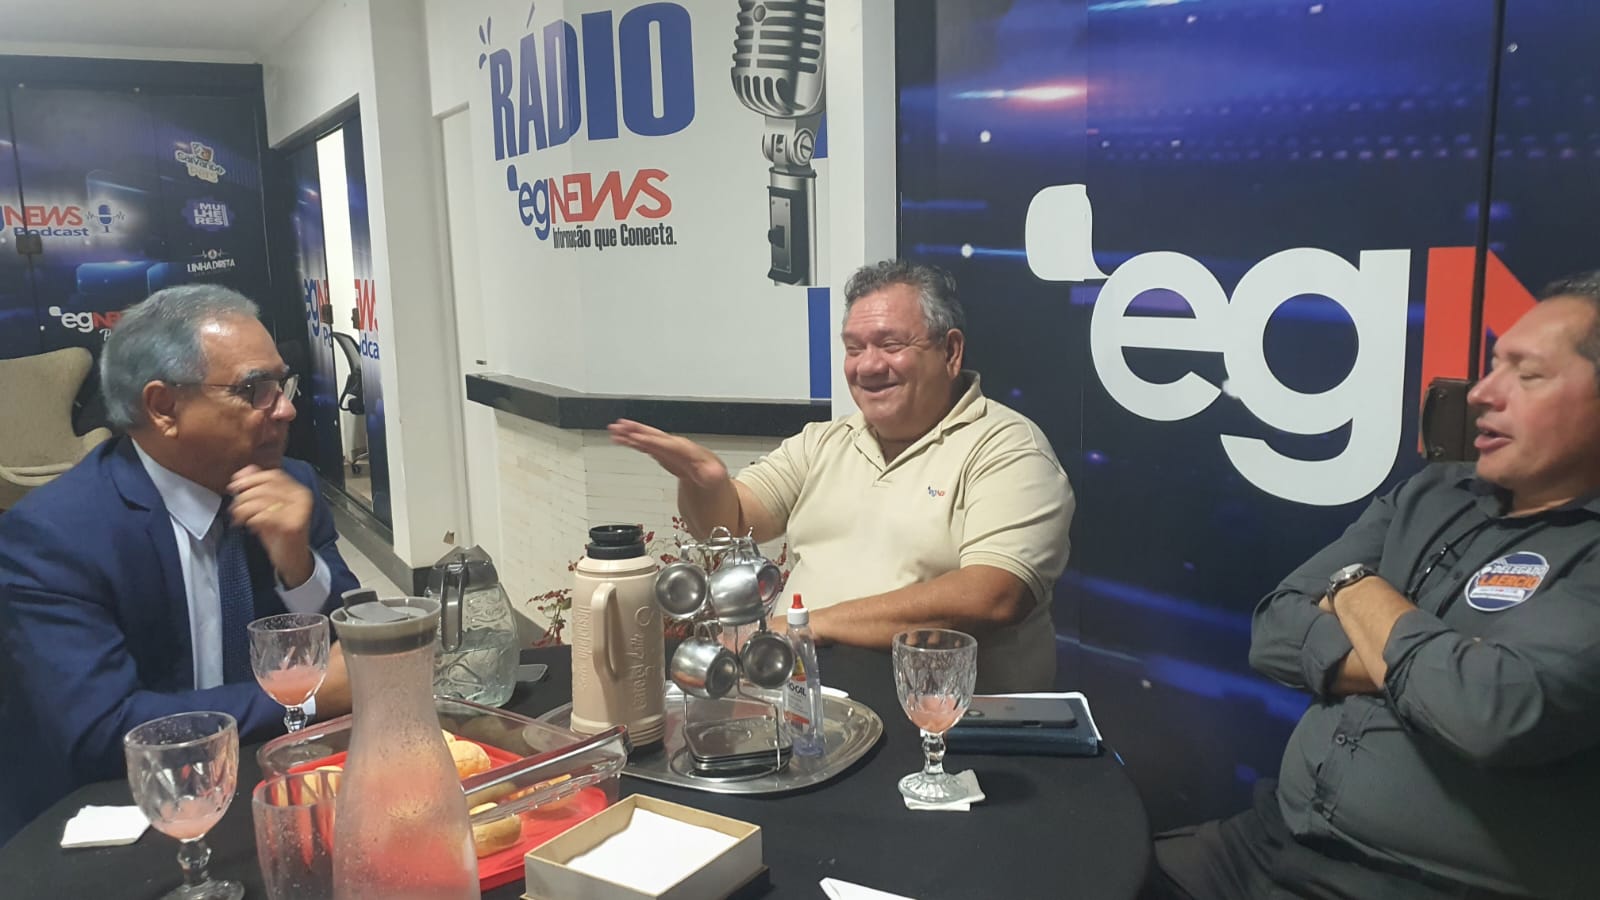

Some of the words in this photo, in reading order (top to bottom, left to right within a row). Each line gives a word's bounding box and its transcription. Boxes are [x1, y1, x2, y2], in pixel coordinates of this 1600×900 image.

[489, 2, 695, 161] RÁDIO
[0, 205, 83, 231] NEWS
[14, 226, 89, 237] Podcast
[594, 228, 617, 250] que
[620, 222, 677, 246] Conecta.
